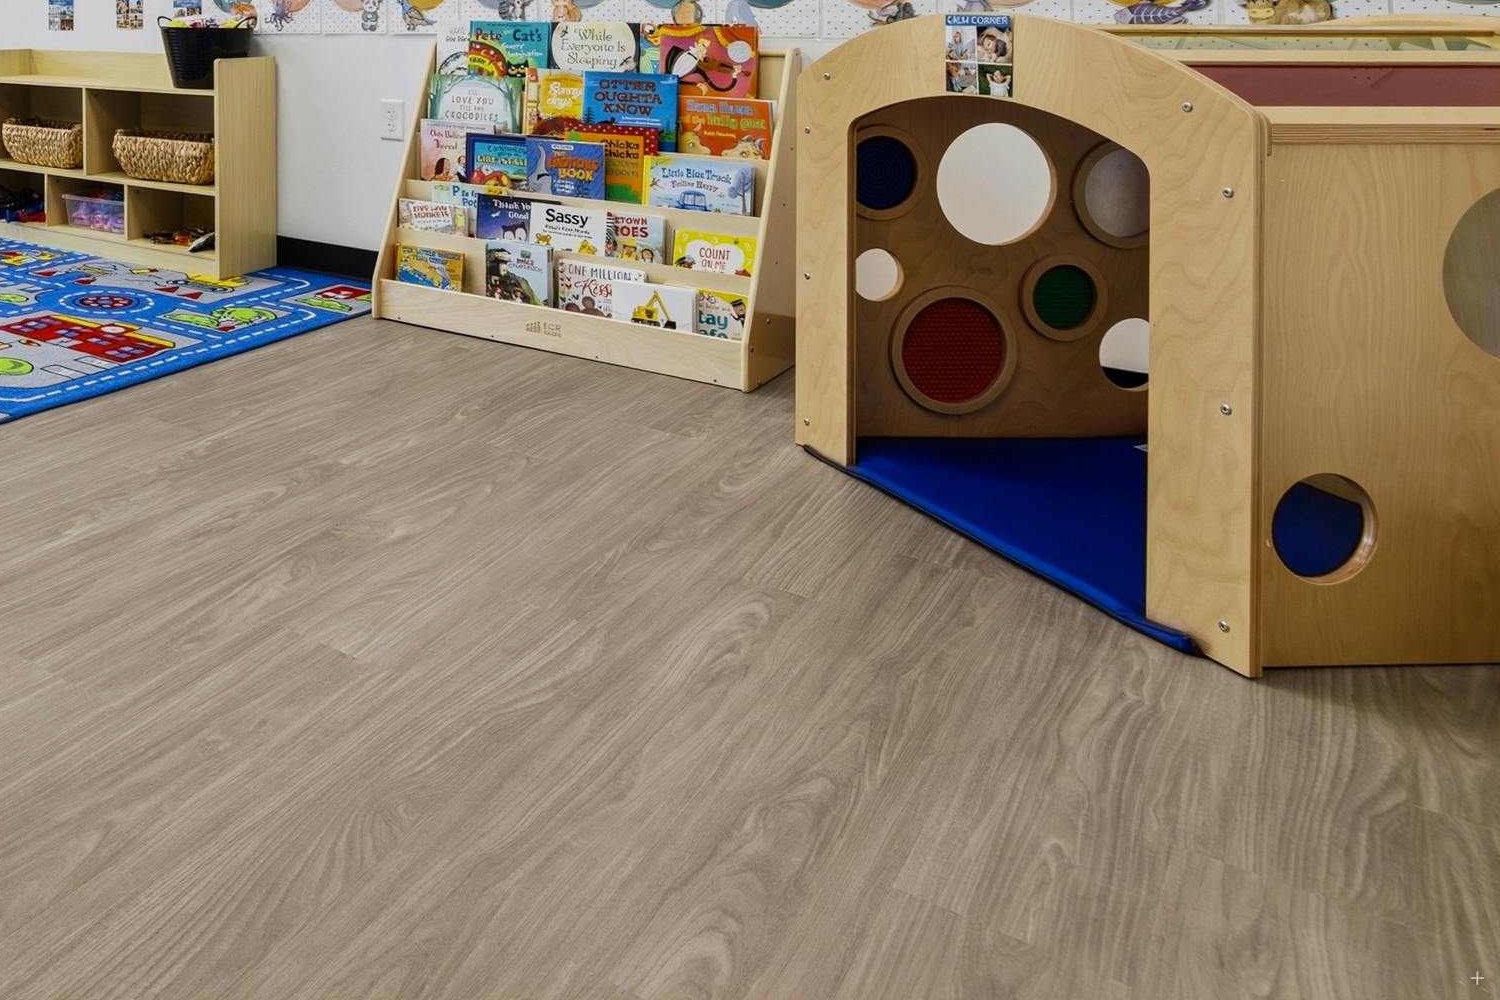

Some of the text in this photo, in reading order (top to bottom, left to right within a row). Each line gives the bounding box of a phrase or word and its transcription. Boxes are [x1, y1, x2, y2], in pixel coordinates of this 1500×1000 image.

[947, 15, 1008, 25] CALM CORNER
[476, 28, 502, 41] Pete
[513, 28, 542, 42] Cat's
[577, 28, 613, 42] While
[560, 41, 626, 54] Everyone Is
[566, 52, 618, 68] Sleeping
[598, 79, 656, 92] OTTER
[451, 96, 494, 106] LOVE YOU
[594, 91, 663, 105] OUGHTA
[445, 110, 499, 121] CROCODILES
[602, 103, 654, 115] KNOW
[601, 138, 640, 150] Chicka
[558, 168, 594, 181] BOOK
[661, 167, 733, 185] Little Blue Truck
[452, 184, 460, 196] P
[492, 199, 531, 210] Thank Yo
[545, 208, 589, 229] Sassy
[699, 247, 731, 262] COUNT
[701, 259, 726, 271] ON ME
[568, 264, 631, 281] ONE MILLION
[698, 310, 728, 330] tay
